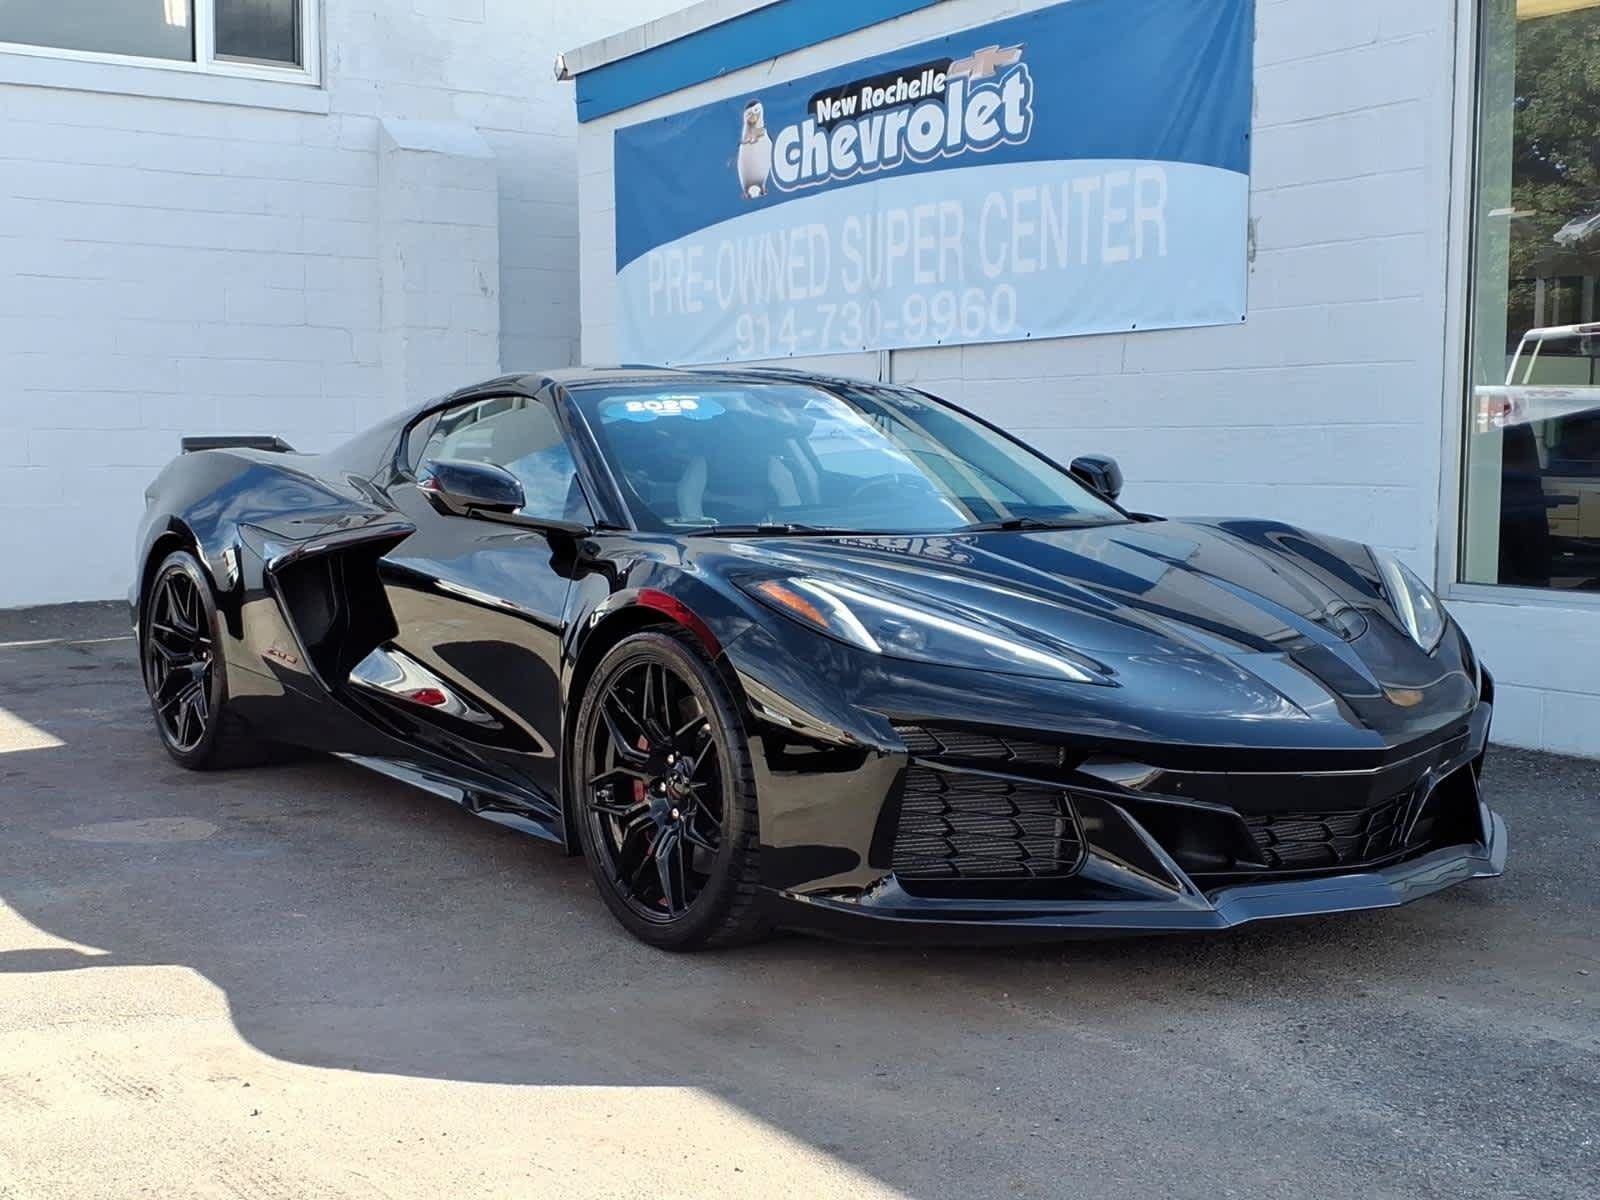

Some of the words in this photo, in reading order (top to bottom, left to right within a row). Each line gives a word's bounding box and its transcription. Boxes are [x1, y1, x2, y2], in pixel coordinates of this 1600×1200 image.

[773, 71, 1026, 183] Chevrolet
[816, 96, 858, 124] New
[860, 69, 946, 112] Rochelle
[648, 223, 831, 317] PRE-OWNED
[841, 199, 965, 294] SUPER
[979, 165, 1168, 279] CENTER
[735, 284, 1018, 355] 914-730-9960
